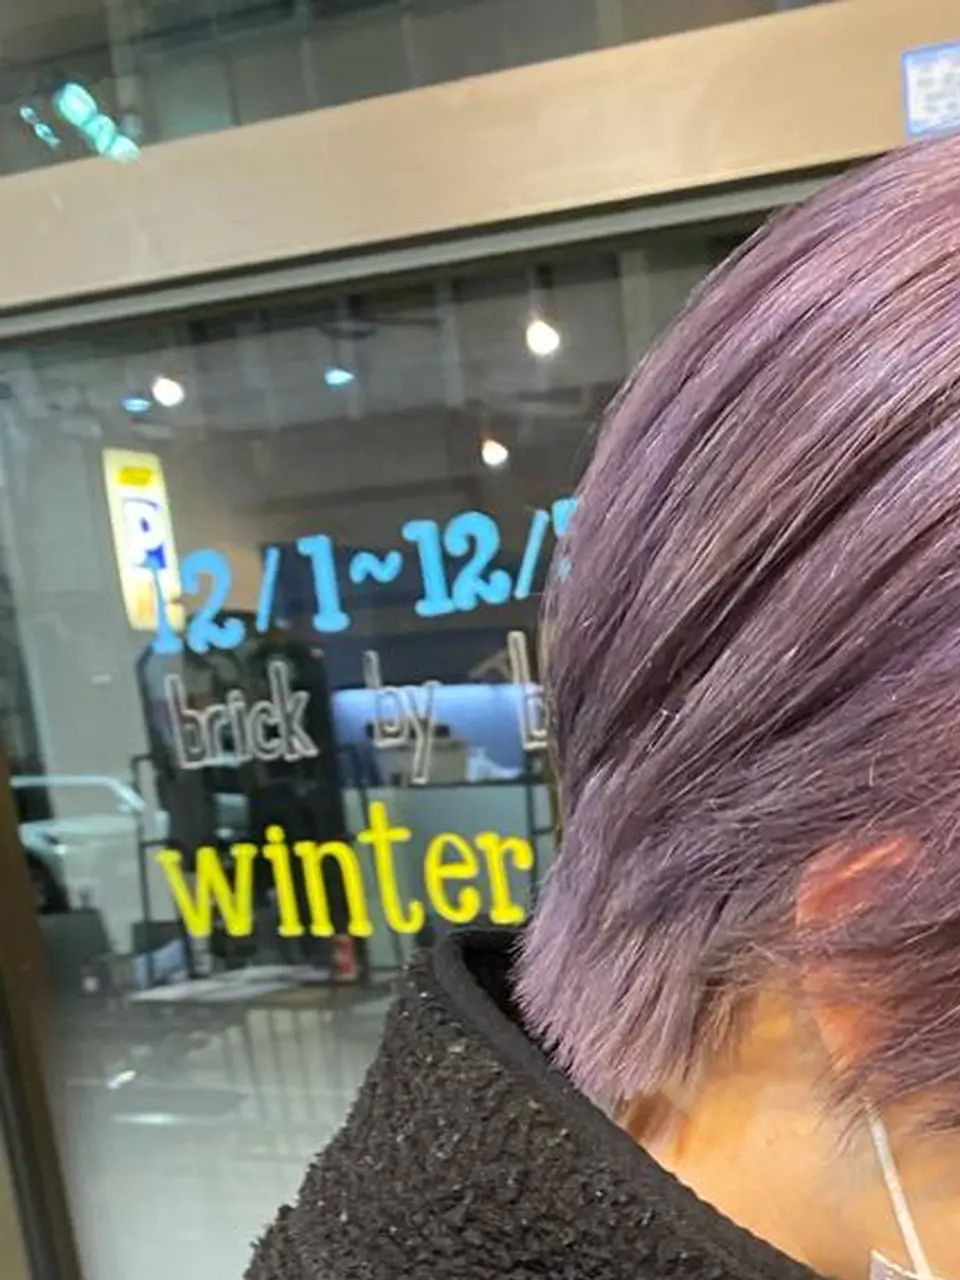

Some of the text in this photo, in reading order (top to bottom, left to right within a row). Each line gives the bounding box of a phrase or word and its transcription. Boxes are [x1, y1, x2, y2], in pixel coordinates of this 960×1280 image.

[165, 630, 548, 784] brick by b
[156, 800, 534, 939] winter
